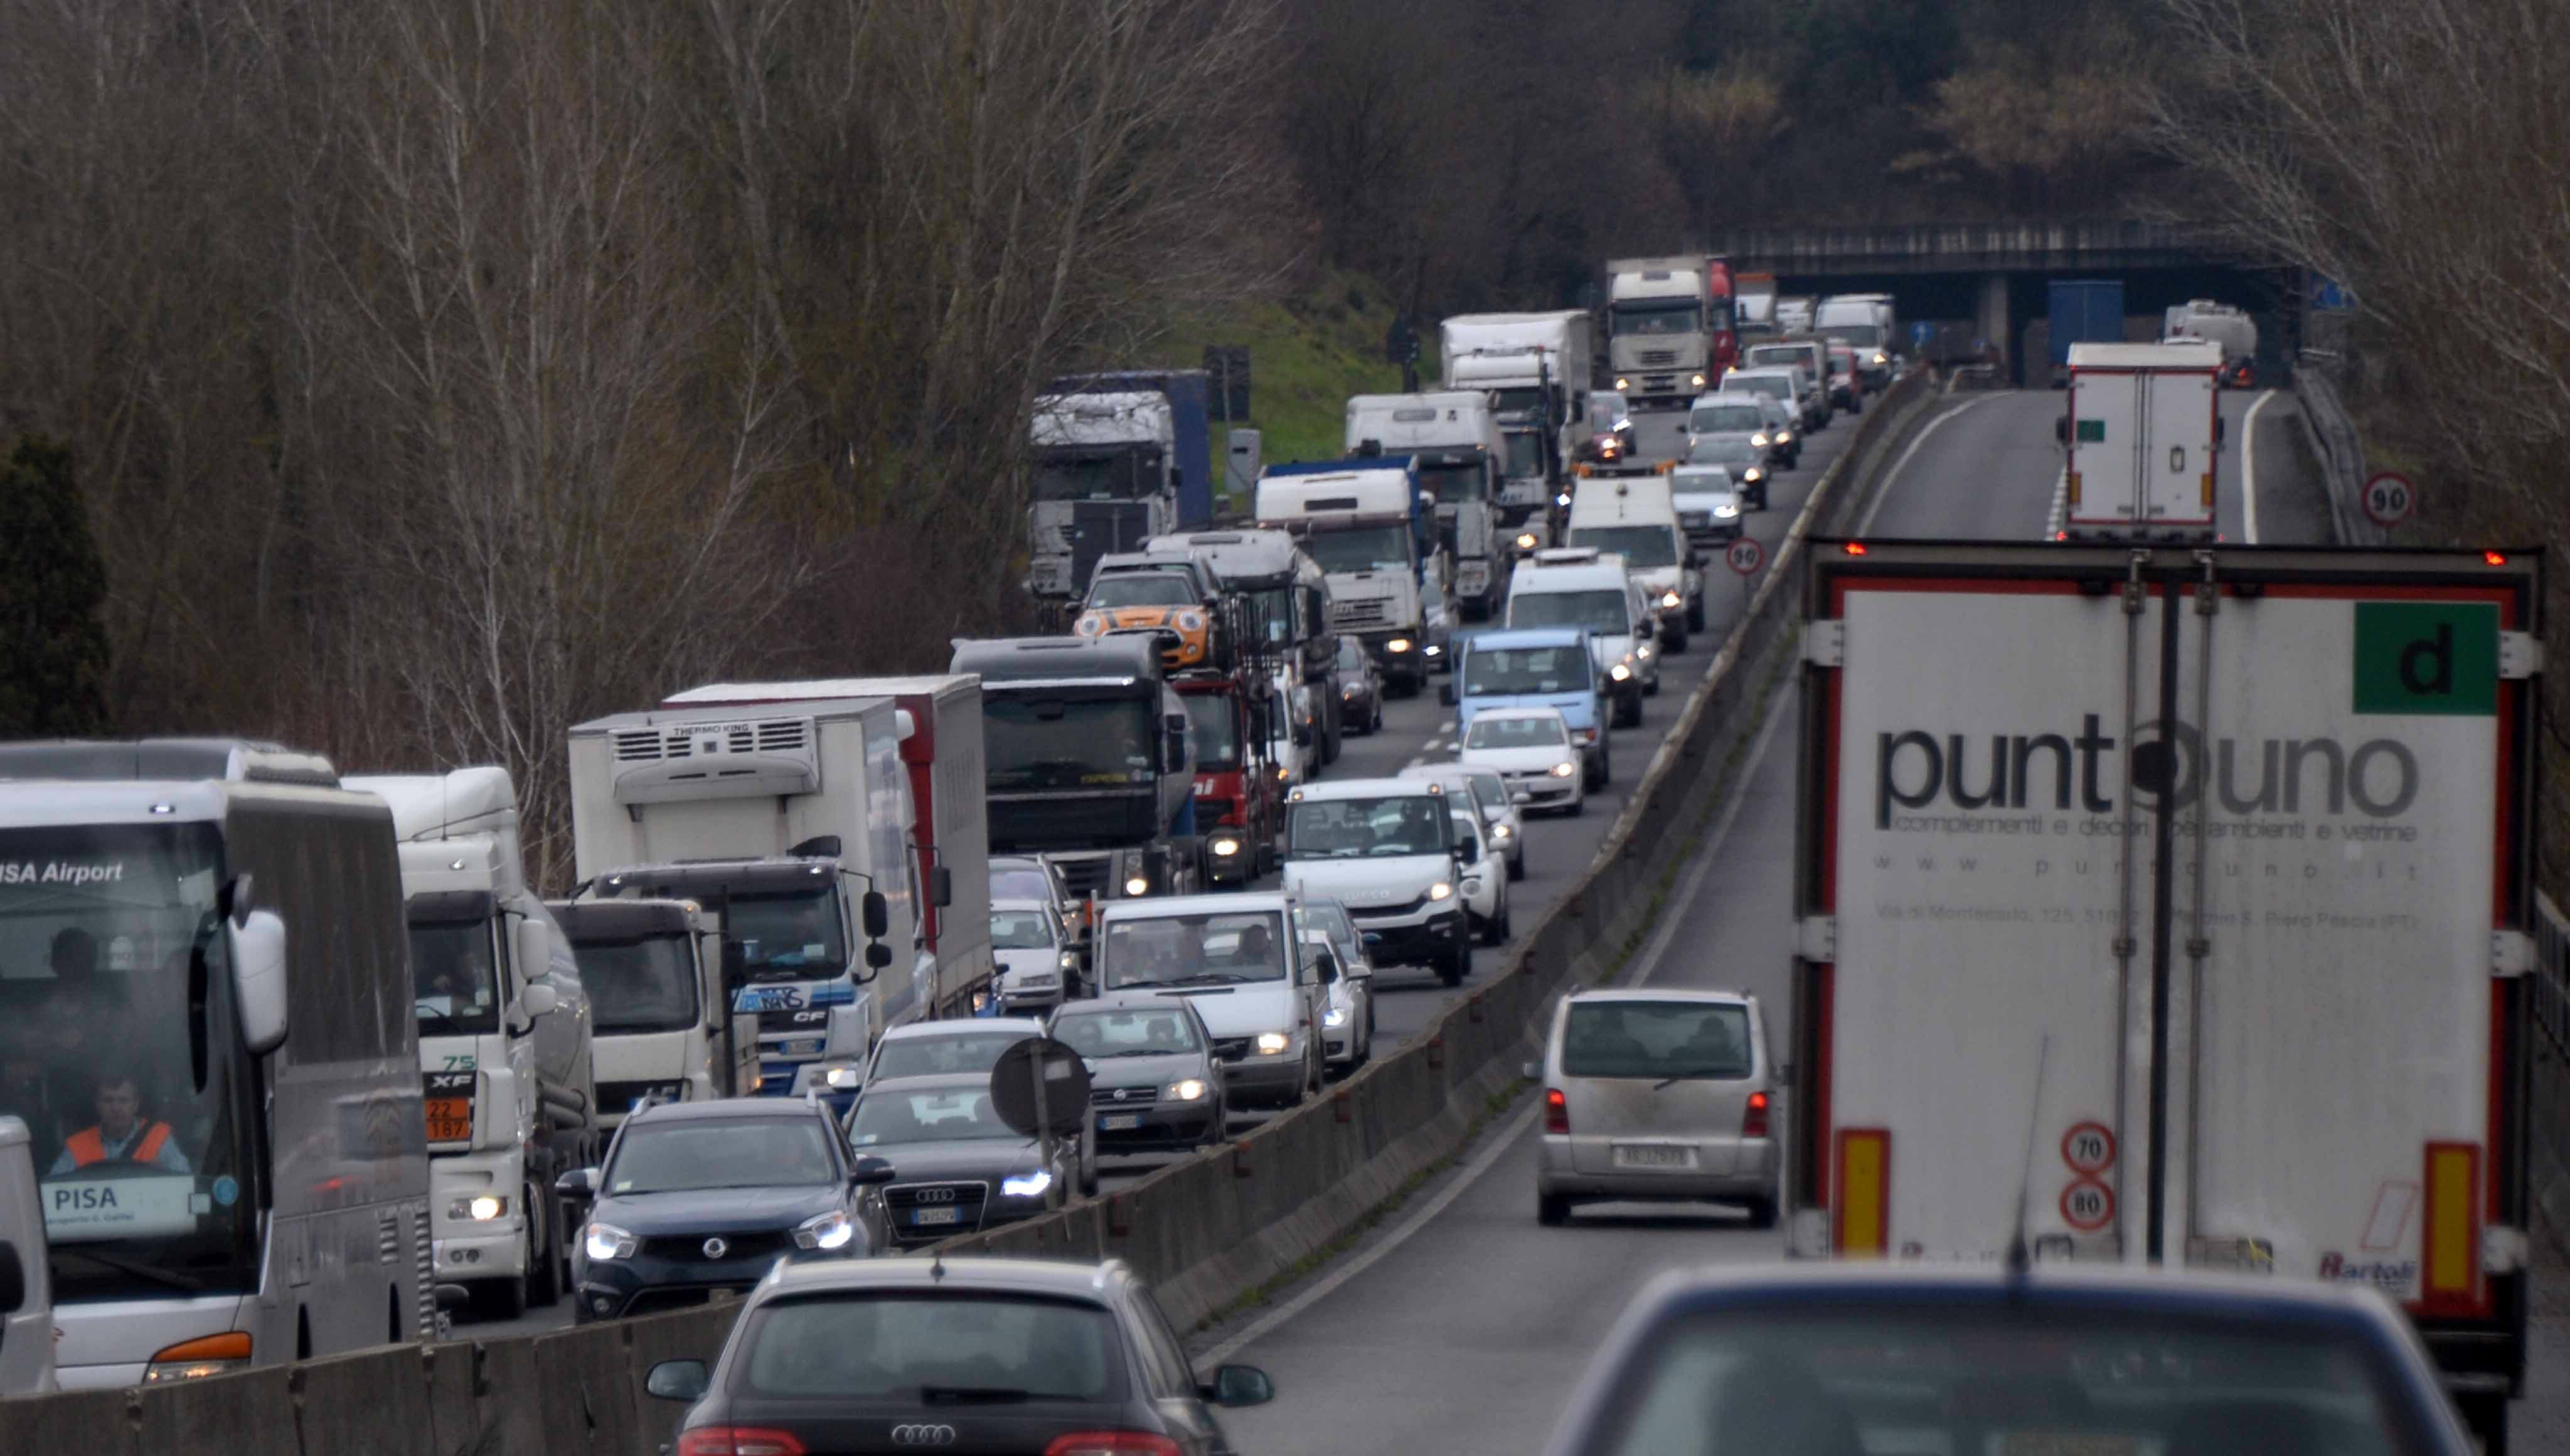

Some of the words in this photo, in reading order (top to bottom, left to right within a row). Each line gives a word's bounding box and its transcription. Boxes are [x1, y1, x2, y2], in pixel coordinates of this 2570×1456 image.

[2373, 488, 2405, 512] 90
[2400, 624, 2451, 694] d
[673, 725, 721, 736] THERMO
[722, 723, 749, 733] KING
[1895, 815, 2041, 836] complementi
[2053, 820, 2068, 836] e
[2079, 816, 2148, 837] decri
[2316, 825, 2330, 841] e
[2340, 821, 2417, 842] vetrine
[41, 861, 123, 886] Airport
[794, 1011, 826, 1022] CF
[443, 1055, 477, 1073] 75
[431, 1075, 473, 1088] XF
[2077, 1135, 2101, 1160] 70
[55, 1187, 117, 1210] PISA
[2074, 1192, 2100, 1216] 80
